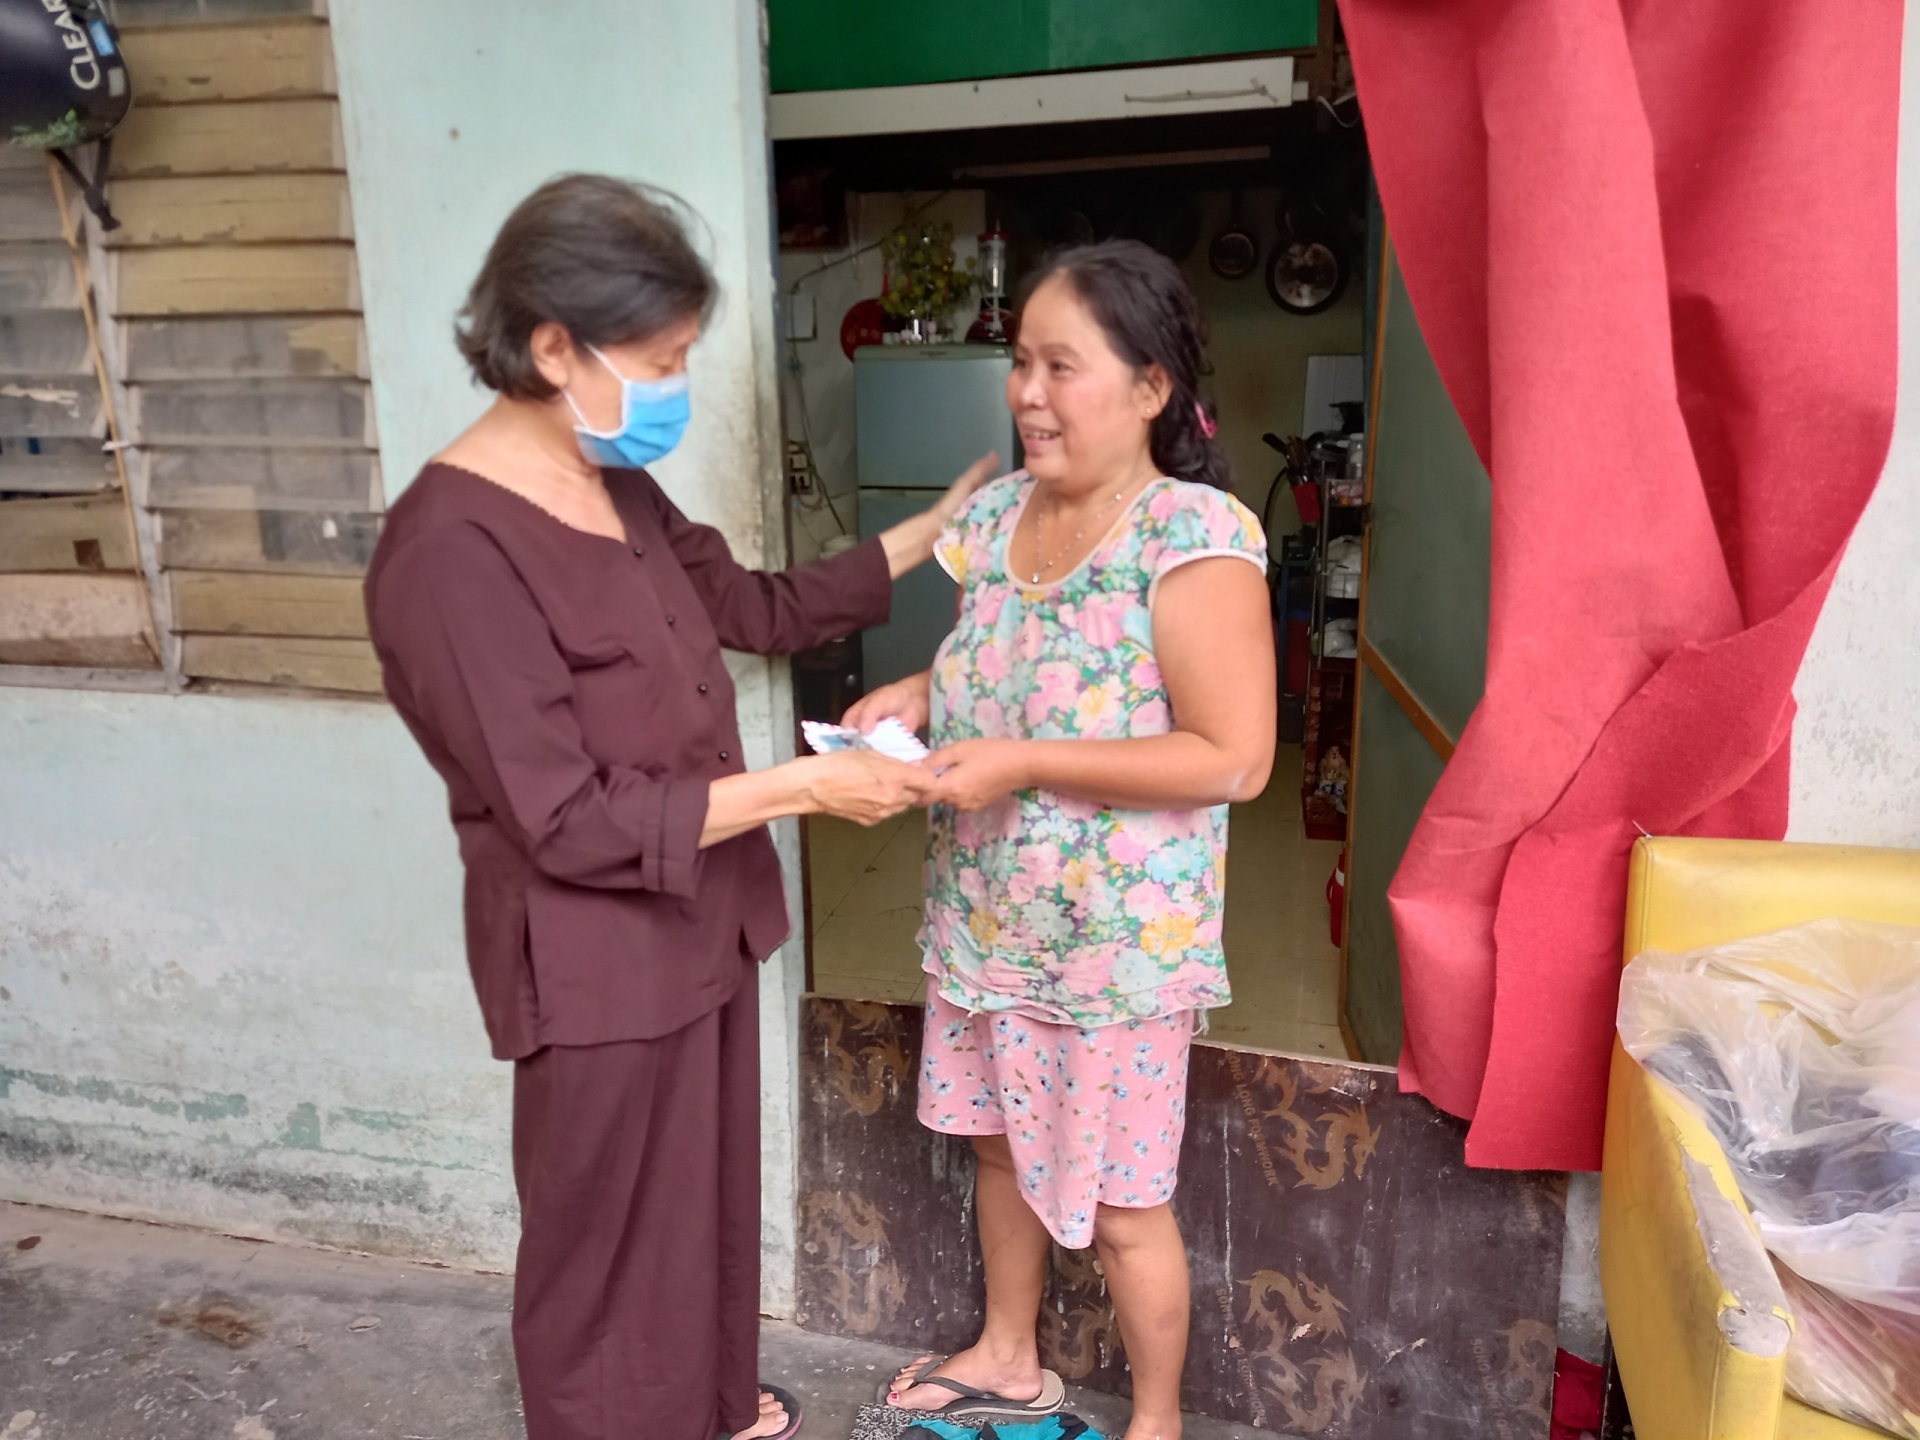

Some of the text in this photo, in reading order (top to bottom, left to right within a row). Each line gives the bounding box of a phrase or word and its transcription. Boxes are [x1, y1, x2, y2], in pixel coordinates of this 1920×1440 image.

[1226, 1050, 1280, 1187] SONG LONG FORMWORK
[1470, 1338, 1491, 1372] SONG
